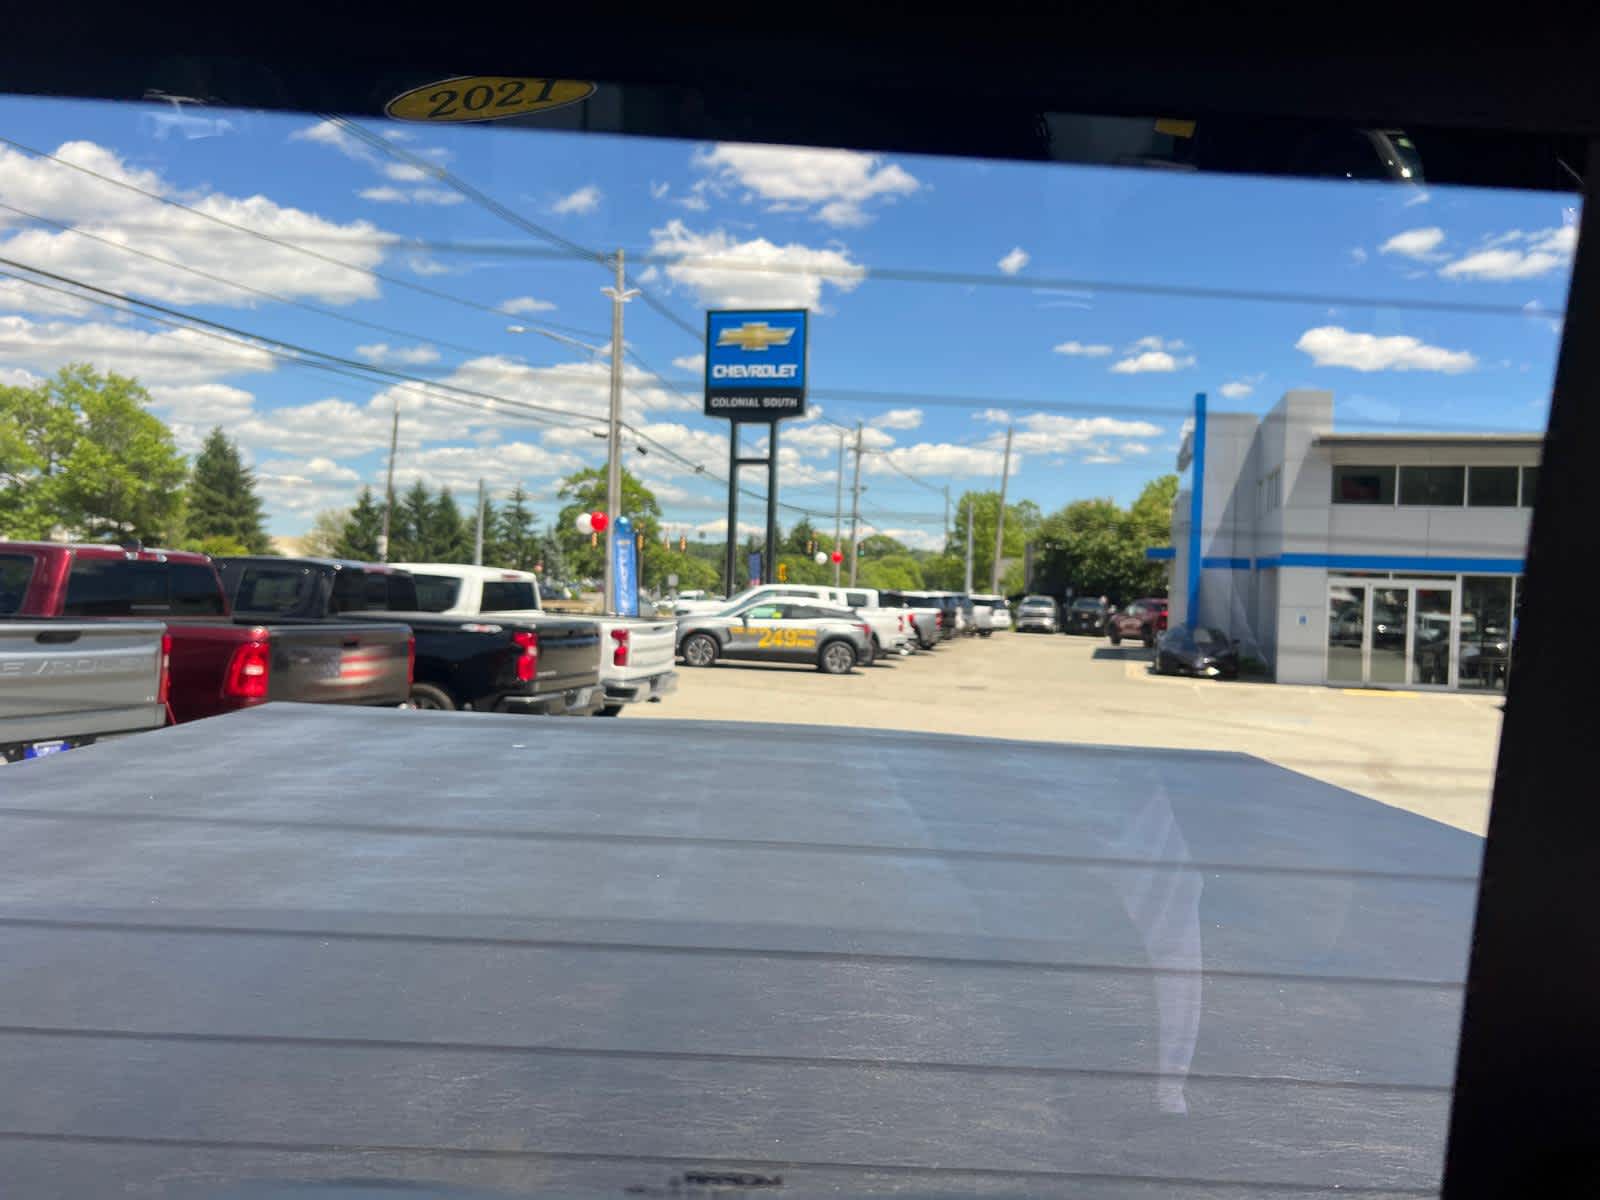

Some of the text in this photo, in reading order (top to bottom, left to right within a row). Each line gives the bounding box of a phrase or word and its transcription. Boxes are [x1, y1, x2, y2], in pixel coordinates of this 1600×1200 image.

[428, 79, 557, 118] 2021
[712, 364, 798, 379] CHEVROLET
[711, 397, 798, 409] COLONIAL SOUTH
